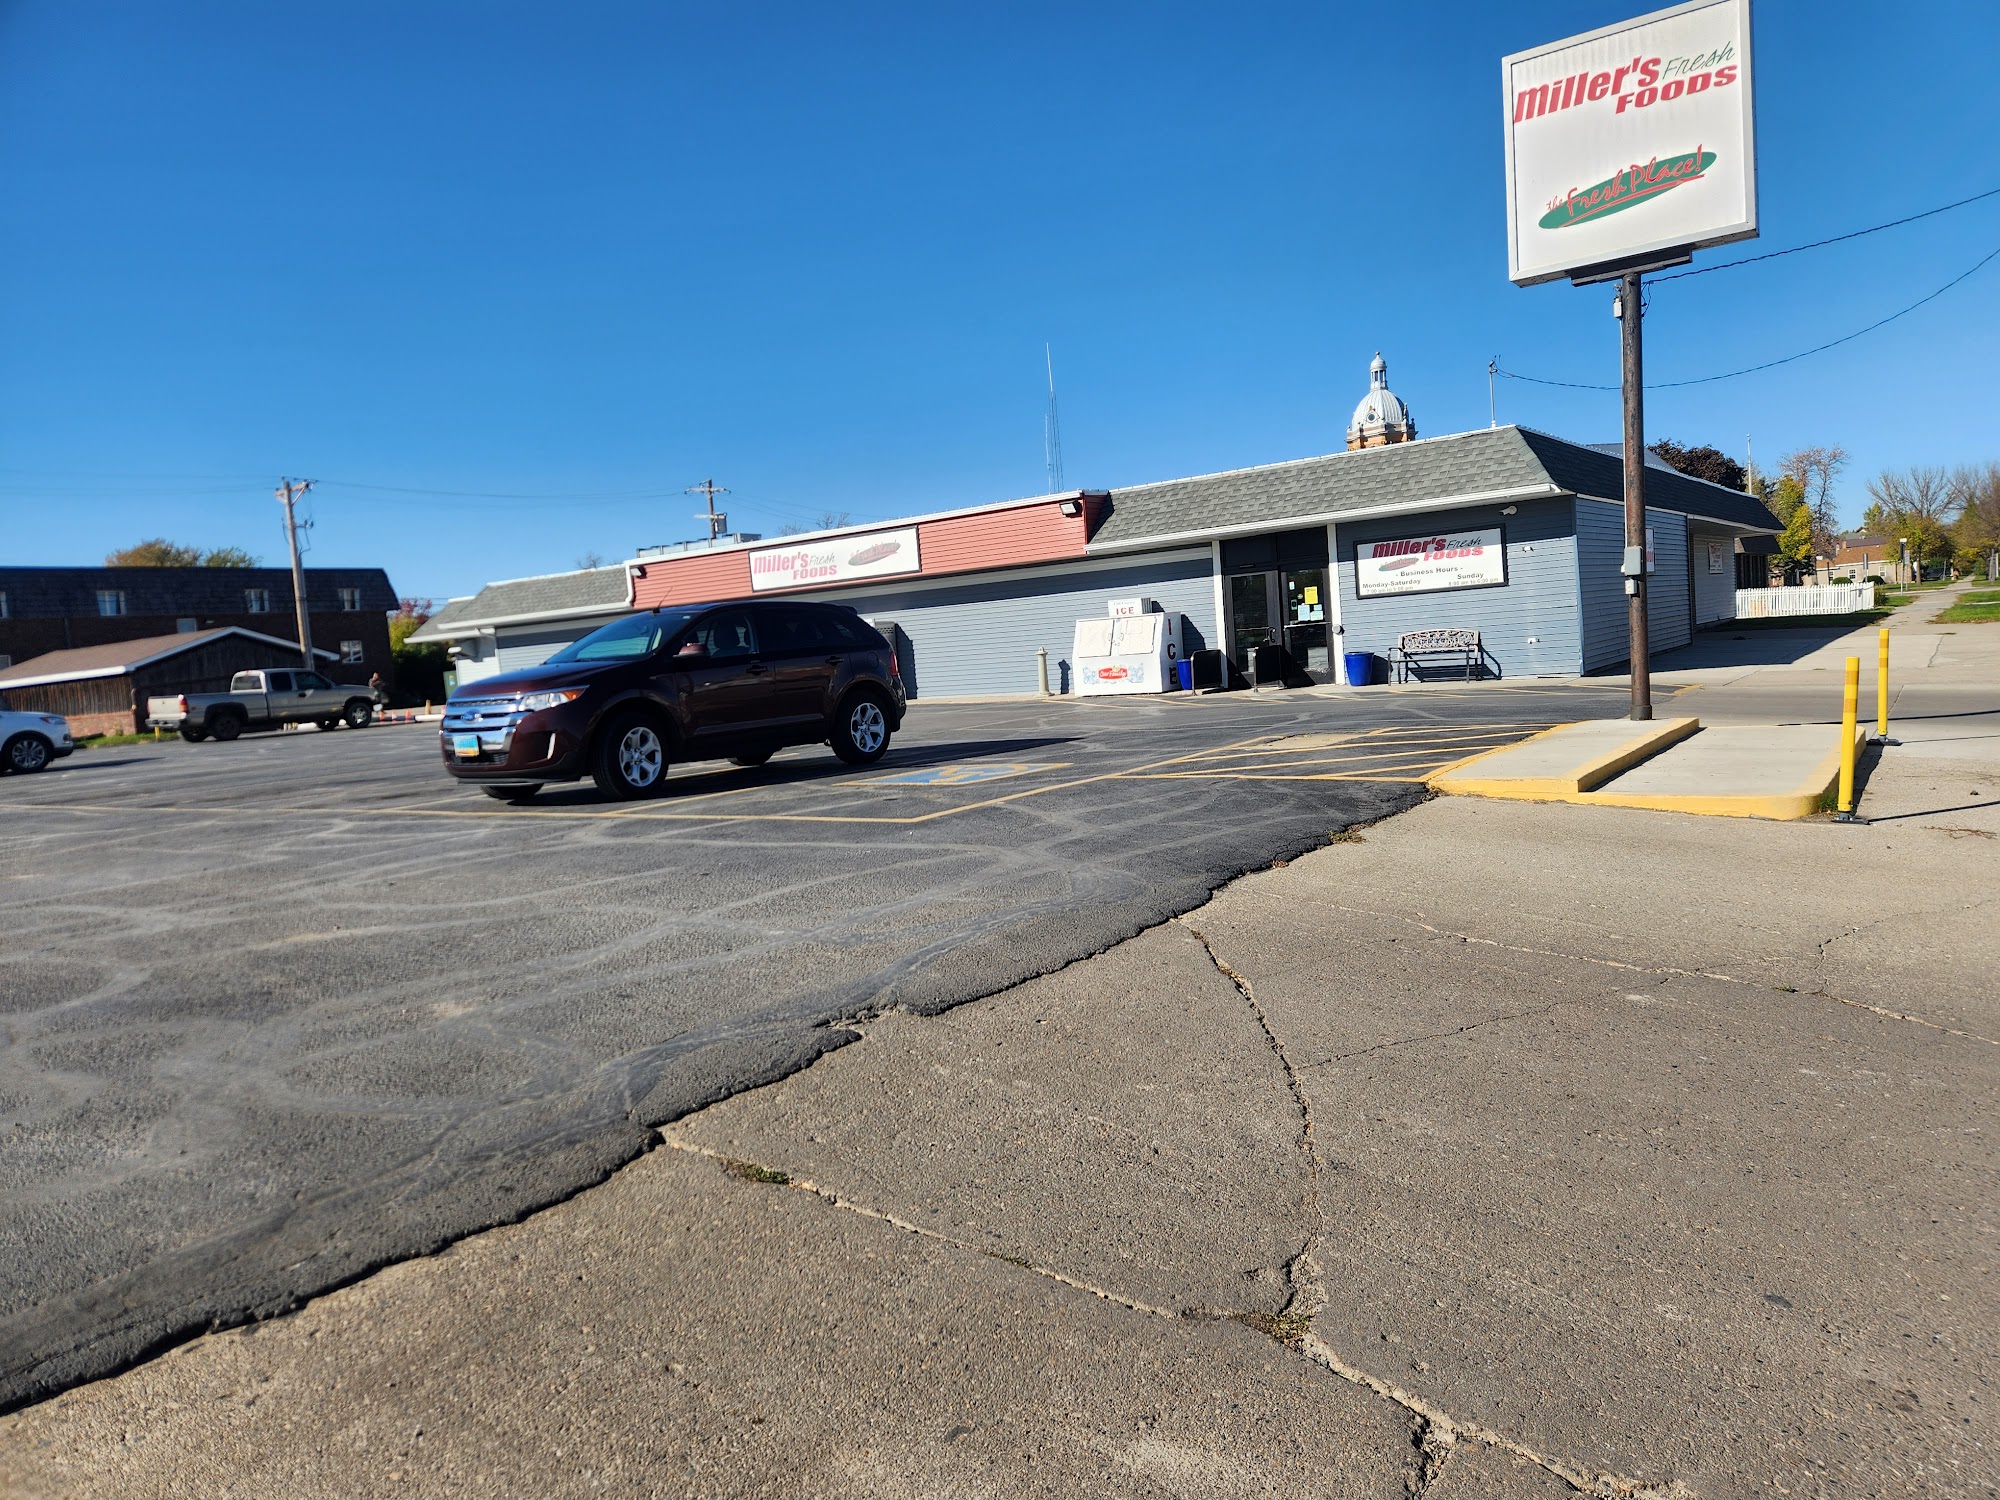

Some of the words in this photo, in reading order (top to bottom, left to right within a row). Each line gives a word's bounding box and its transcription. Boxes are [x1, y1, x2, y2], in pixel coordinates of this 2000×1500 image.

[1662, 41, 1735, 80] Fresh
[1616, 65, 1737, 114] FOODS
[1566, 167, 1627, 216] Fresh
[1629, 143, 1703, 192] Place!
[1447, 537, 1482, 549] Fresh
[809, 552, 836, 567] Fresh
[1423, 547, 1483, 561] FOODS
[793, 565, 837, 580] FOODS
[1400, 569, 1434, 577] Business
[1116, 606, 1135, 615] ICE
